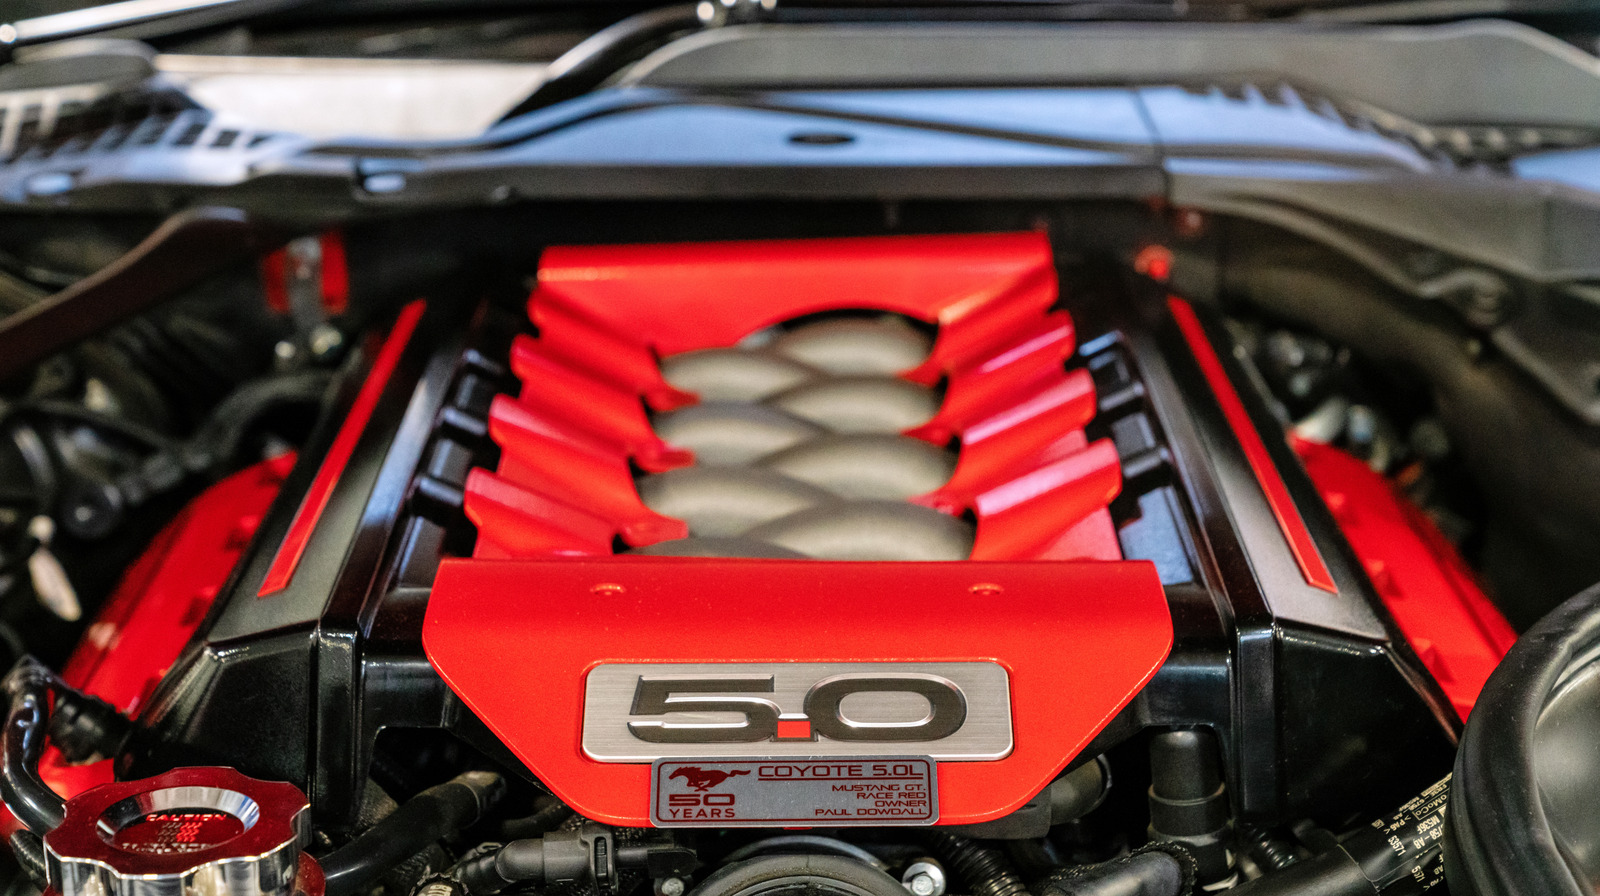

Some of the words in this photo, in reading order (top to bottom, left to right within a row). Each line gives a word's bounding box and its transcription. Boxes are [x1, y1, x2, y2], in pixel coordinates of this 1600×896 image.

[627, 672, 968, 744] 5.0
[758, 765, 863, 777] COYOTE
[873, 764, 924, 776] 5.0L
[832, 784, 900, 792] MUSTANG
[904, 783, 926, 791] GT.
[669, 793, 735, 807] 50
[898, 791, 926, 799] RED
[1415, 794, 1447, 816] oMoCo
[669, 808, 735, 819] YEARS
[815, 808, 852, 816] PAUL
[857, 808, 927, 816] DOWDALL
